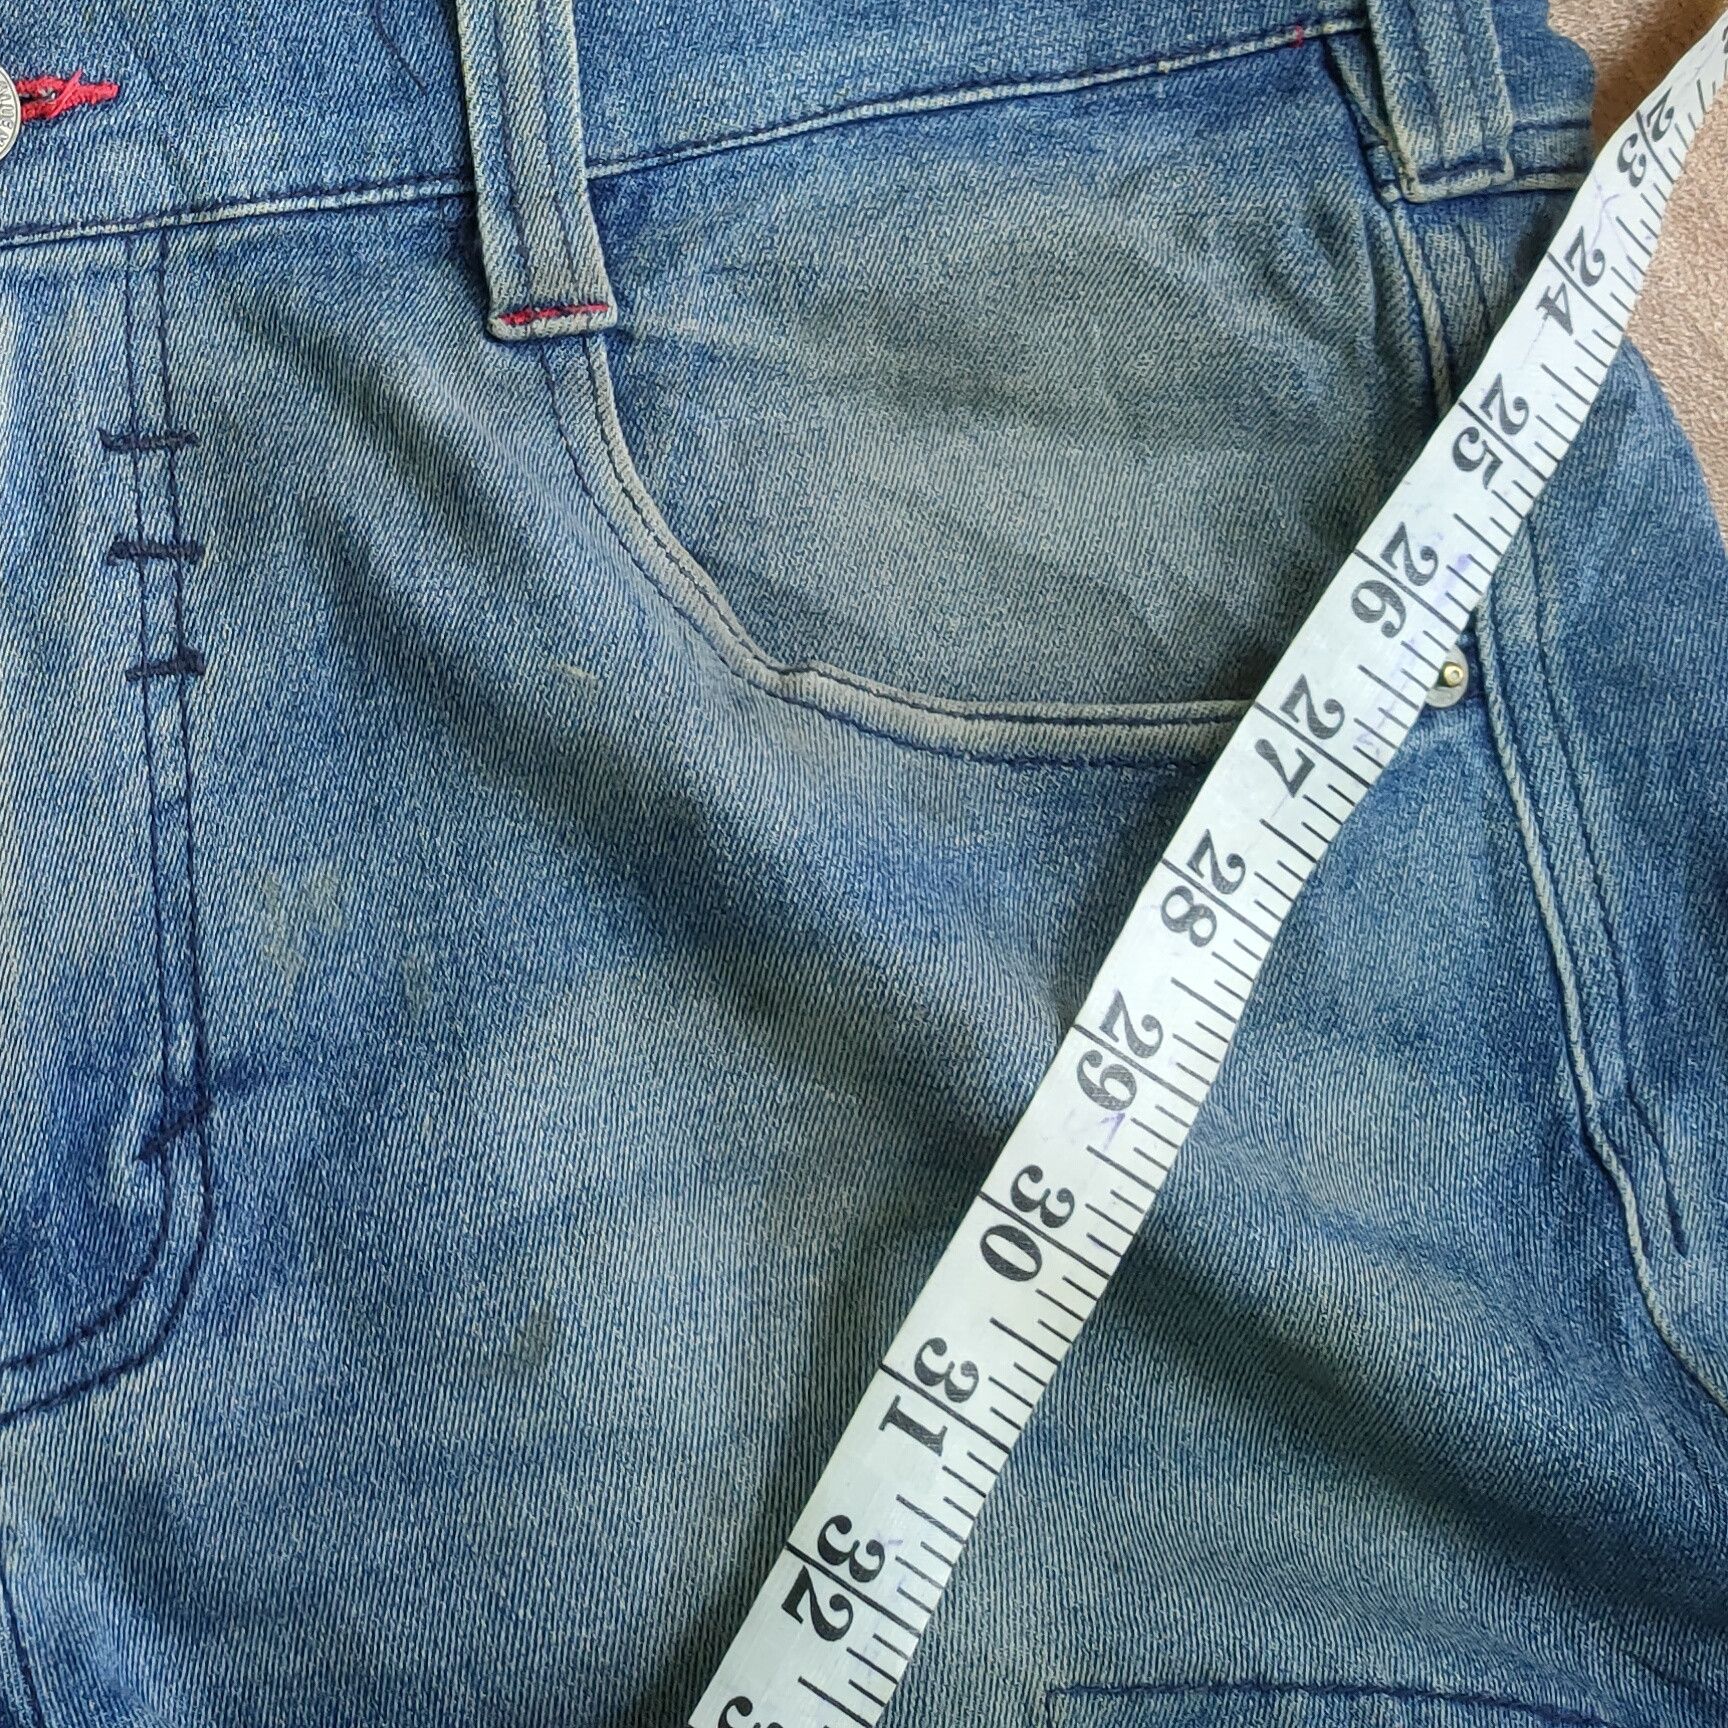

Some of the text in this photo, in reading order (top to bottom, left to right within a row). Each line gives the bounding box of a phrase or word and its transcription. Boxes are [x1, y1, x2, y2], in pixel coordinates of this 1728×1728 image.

[1616, 87, 1674, 188] 23
[1536, 226, 1605, 336] 24
[1453, 373, 1530, 490] 25
[1351, 522, 1439, 639] 26
[1255, 674, 1346, 798] 27
[1160, 829, 1247, 948] 28
[1076, 989, 1163, 1111] 29
[980, 1164, 1072, 1282] 30
[878, 1337, 980, 1458] 31
[782, 1515, 885, 1642] 32
